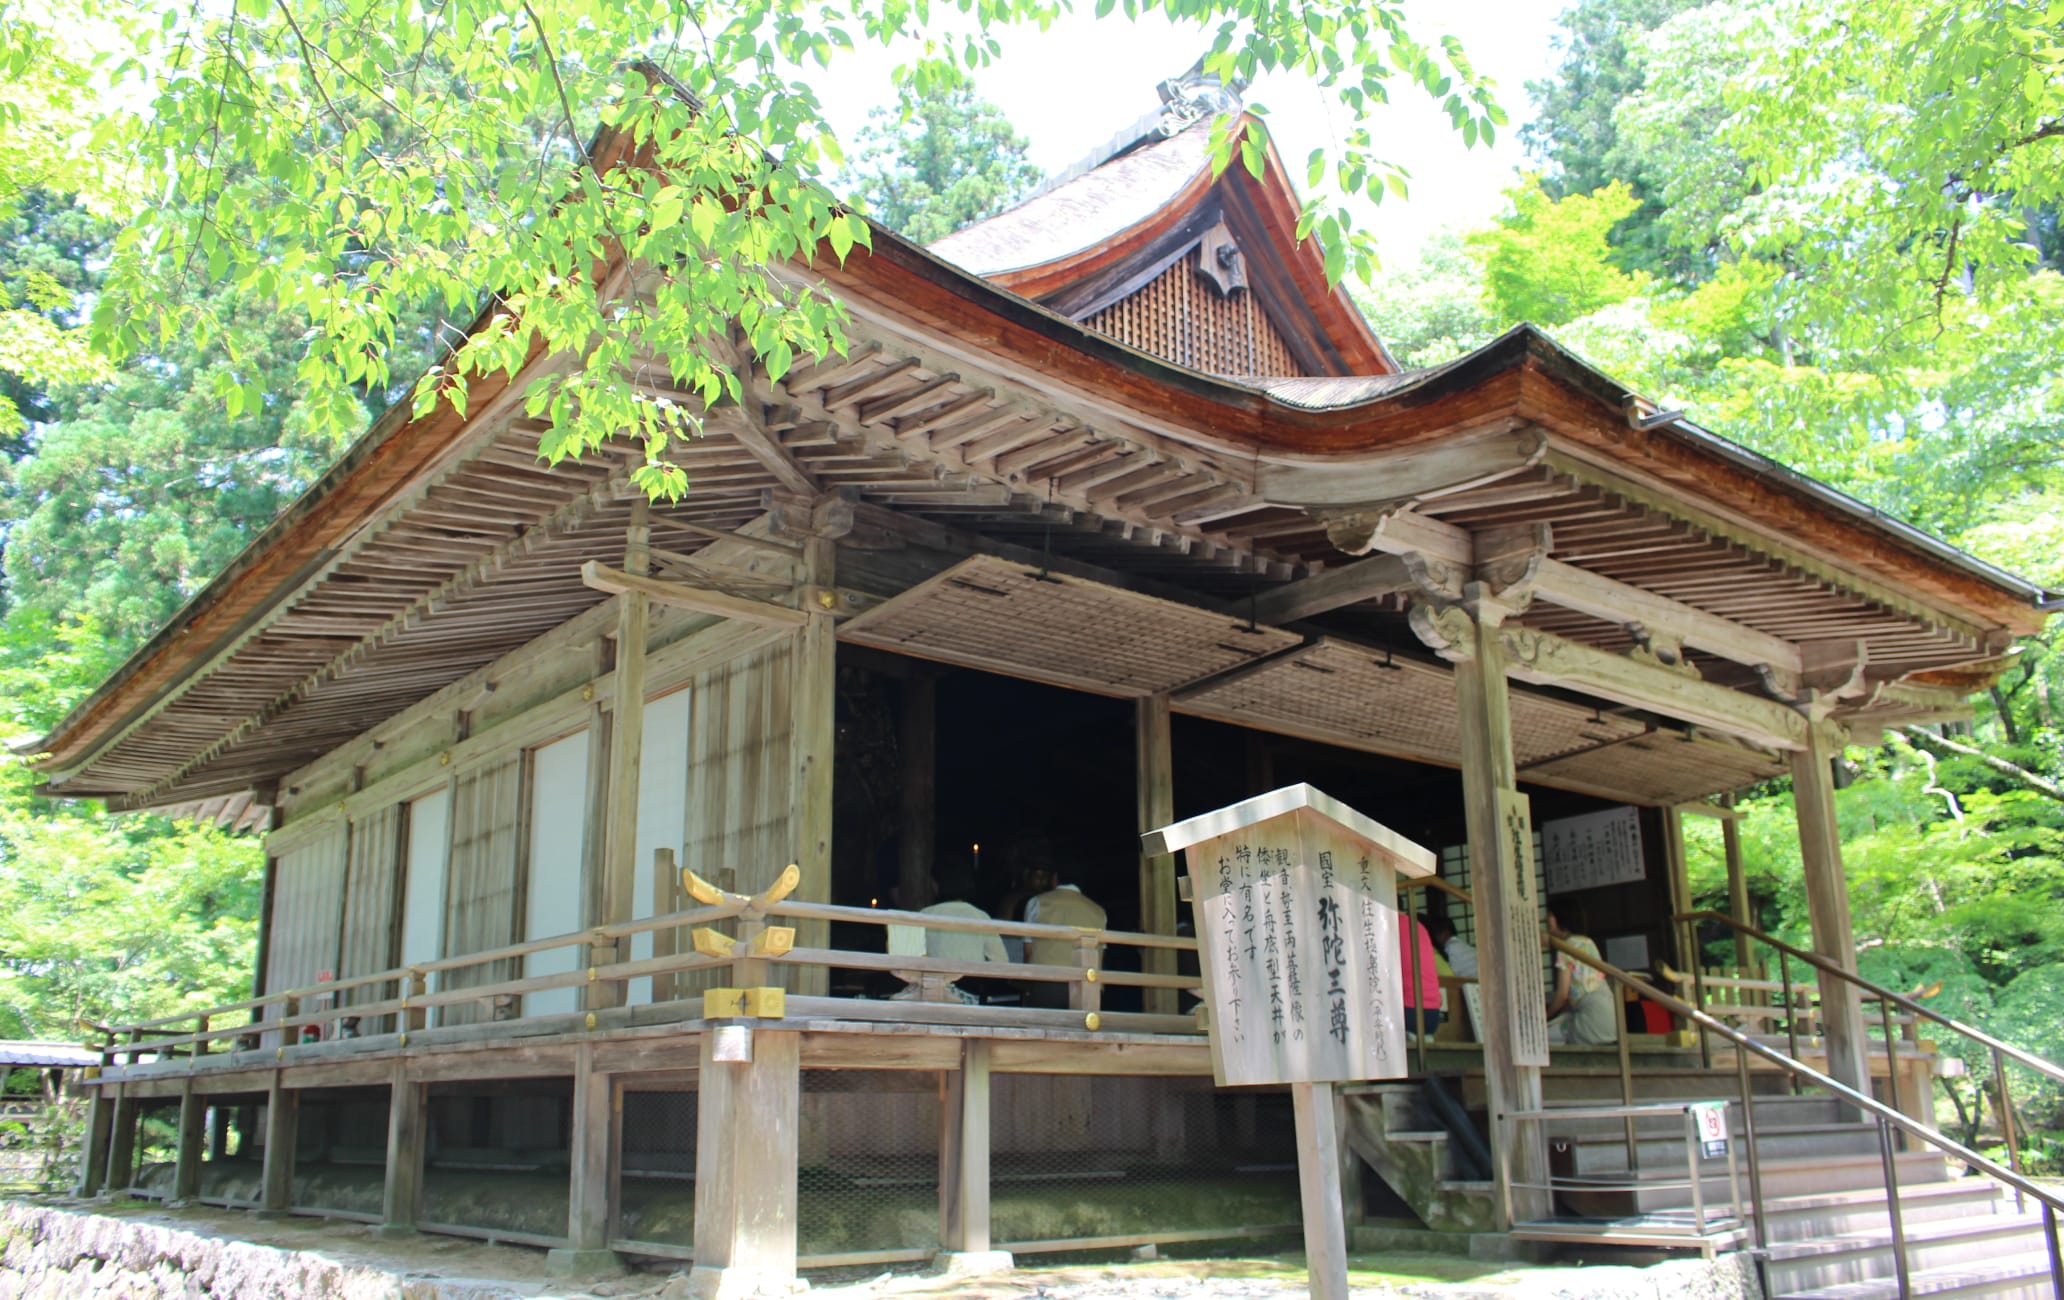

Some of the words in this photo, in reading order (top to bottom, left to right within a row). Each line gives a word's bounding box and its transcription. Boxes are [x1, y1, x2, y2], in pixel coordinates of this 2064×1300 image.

[1235, 845, 1256, 961] 特に有名です
[1317, 896, 1350, 1044] 弥陀三尊
